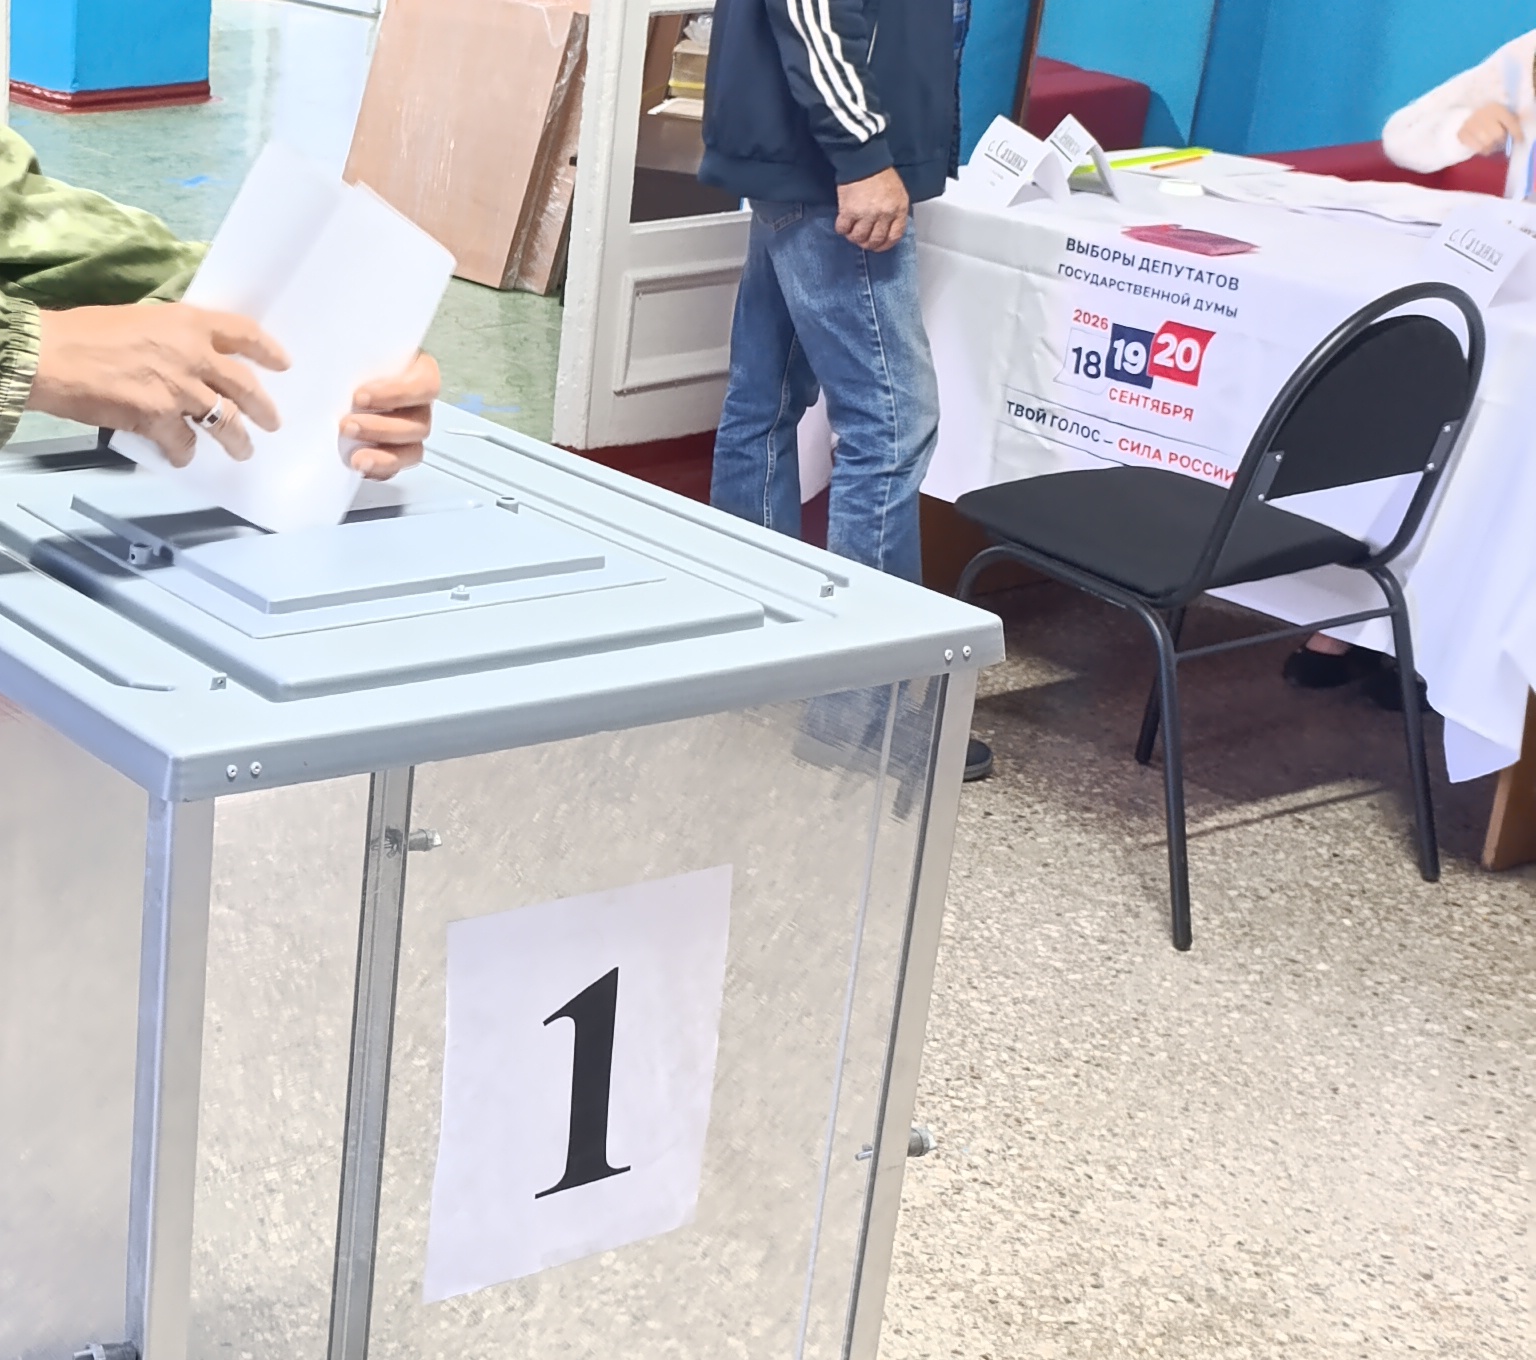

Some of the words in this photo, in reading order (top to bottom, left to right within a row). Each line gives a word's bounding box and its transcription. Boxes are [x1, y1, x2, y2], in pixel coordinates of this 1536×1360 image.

[1058, 263, 1191, 306] ГОСУДАРСТВЕННОЙ
[1193, 298, 1238, 318] ДУМЫ
[1066, 237, 1135, 267] ВЫБОРЫ
[1138, 257, 1239, 291] ДЕПУТАТОВ
[1072, 309, 1109, 330] 2026
[1072, 346, 1102, 379] 18
[1113, 338, 1147, 375] 19
[1153, 332, 1201, 372] 20
[1109, 387, 1194, 422] СЕНТЯБРЯ
[1006, 400, 1046, 425] ТВОЙ
[1050, 415, 1101, 443] ГОЛОС
[1118, 437, 1163, 462] СИЛА
[1168, 451, 1237, 482] РОССИИ
[535, 966, 631, 1199] 1
